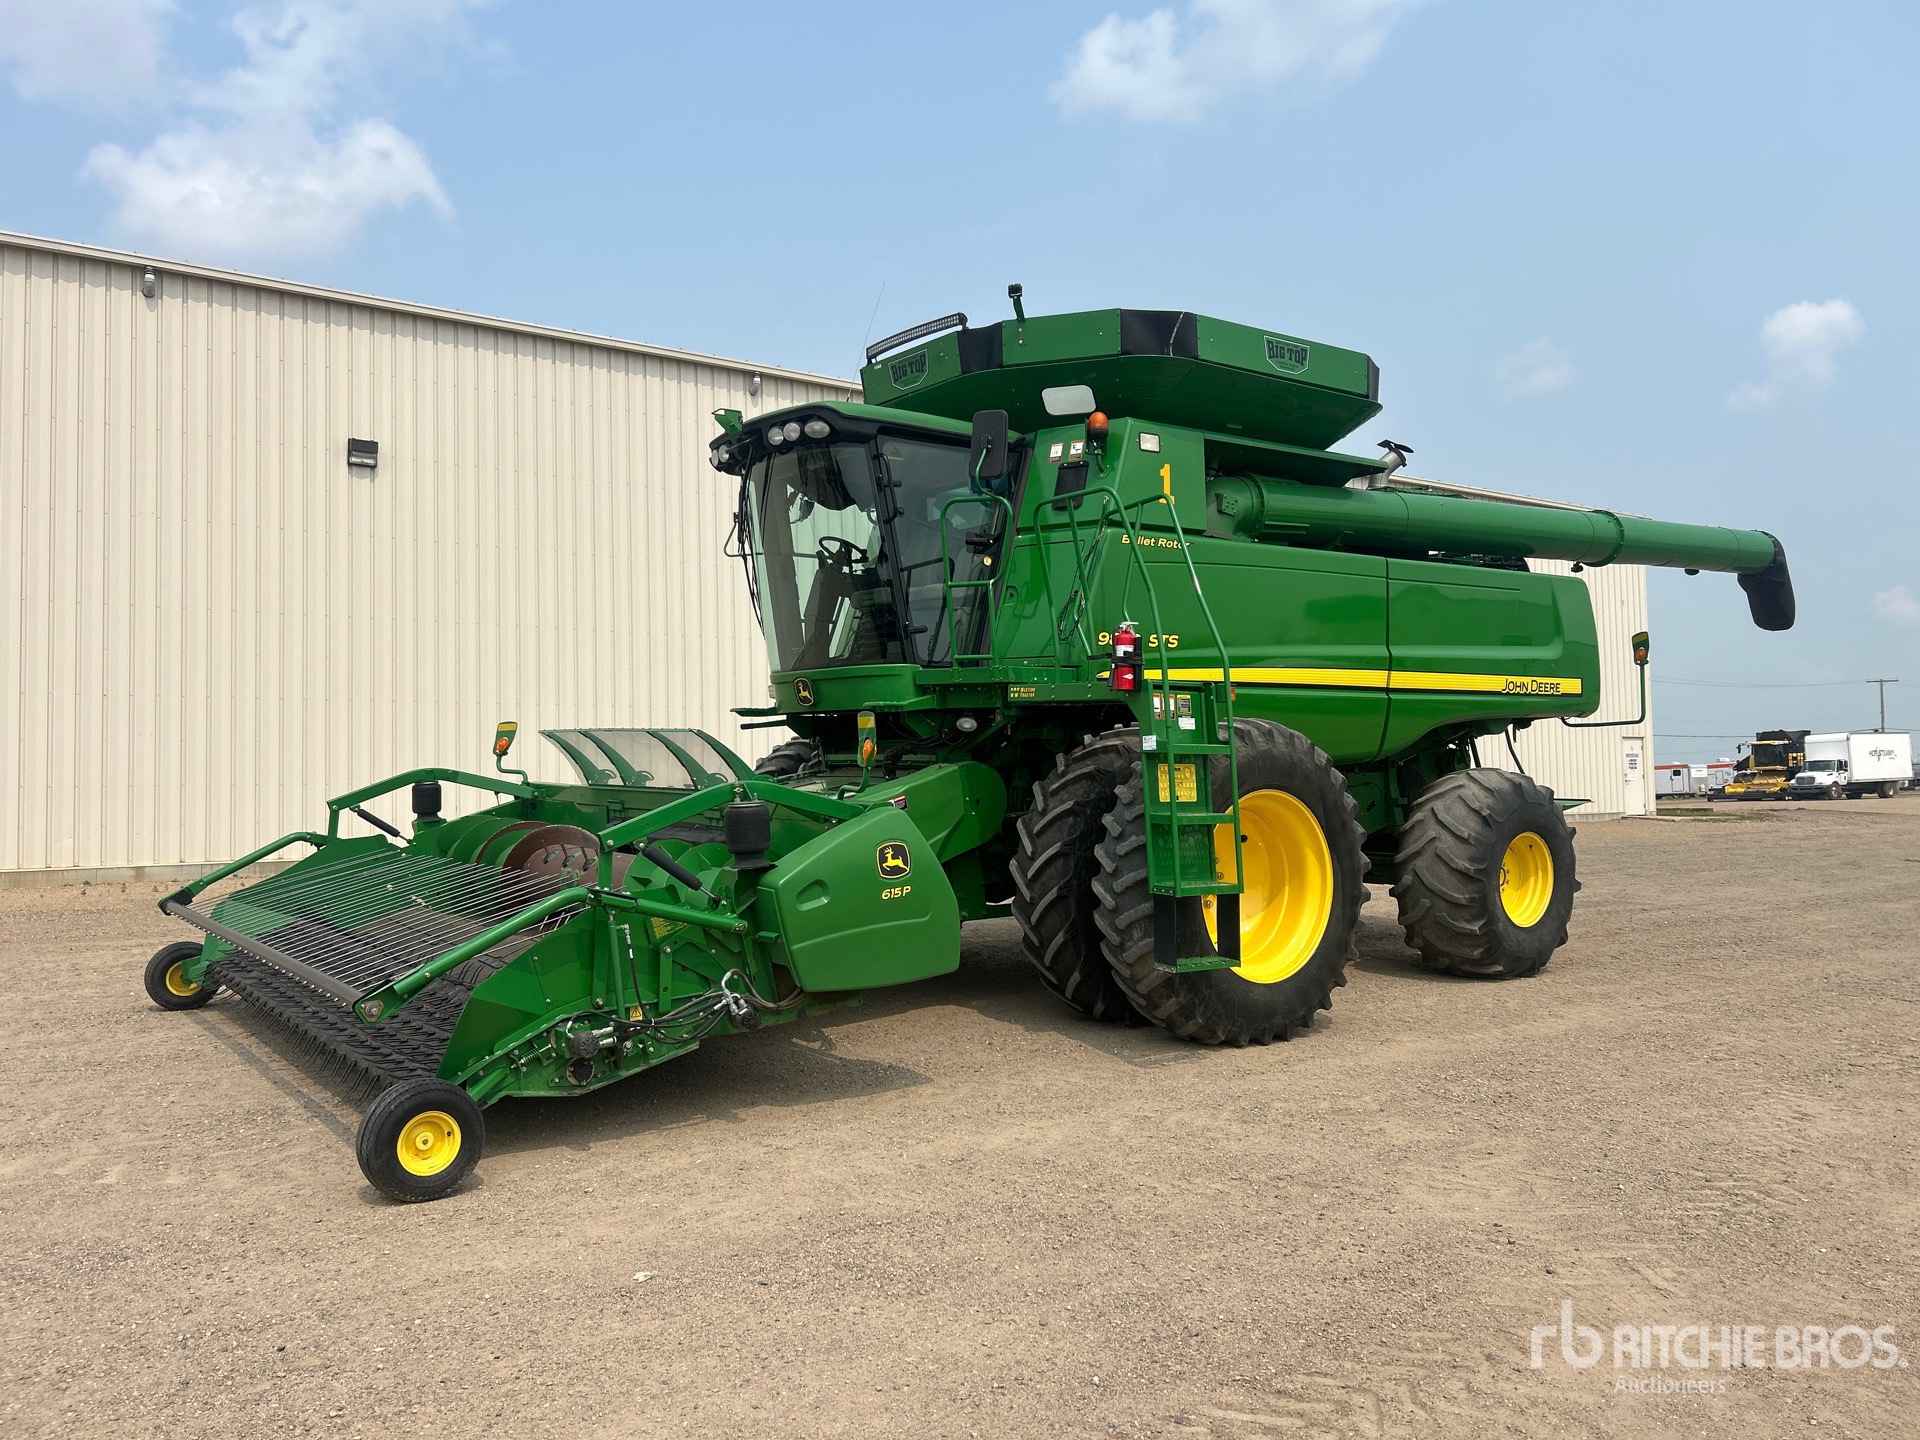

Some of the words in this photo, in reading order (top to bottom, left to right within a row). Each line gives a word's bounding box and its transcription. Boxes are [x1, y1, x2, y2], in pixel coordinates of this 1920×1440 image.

[1267, 340, 1285, 359] BIG
[1287, 346, 1307, 366] TOP
[890, 364, 907, 382] BIG
[908, 354, 926, 374] TOP
[1159, 464, 1175, 505] 1
[1121, 534, 1155, 547] Bllet
[1148, 634, 1179, 648] STS
[1502, 679, 1528, 692] JOHN
[1530, 680, 1560, 693] DEERE
[881, 886, 911, 899] 615P
